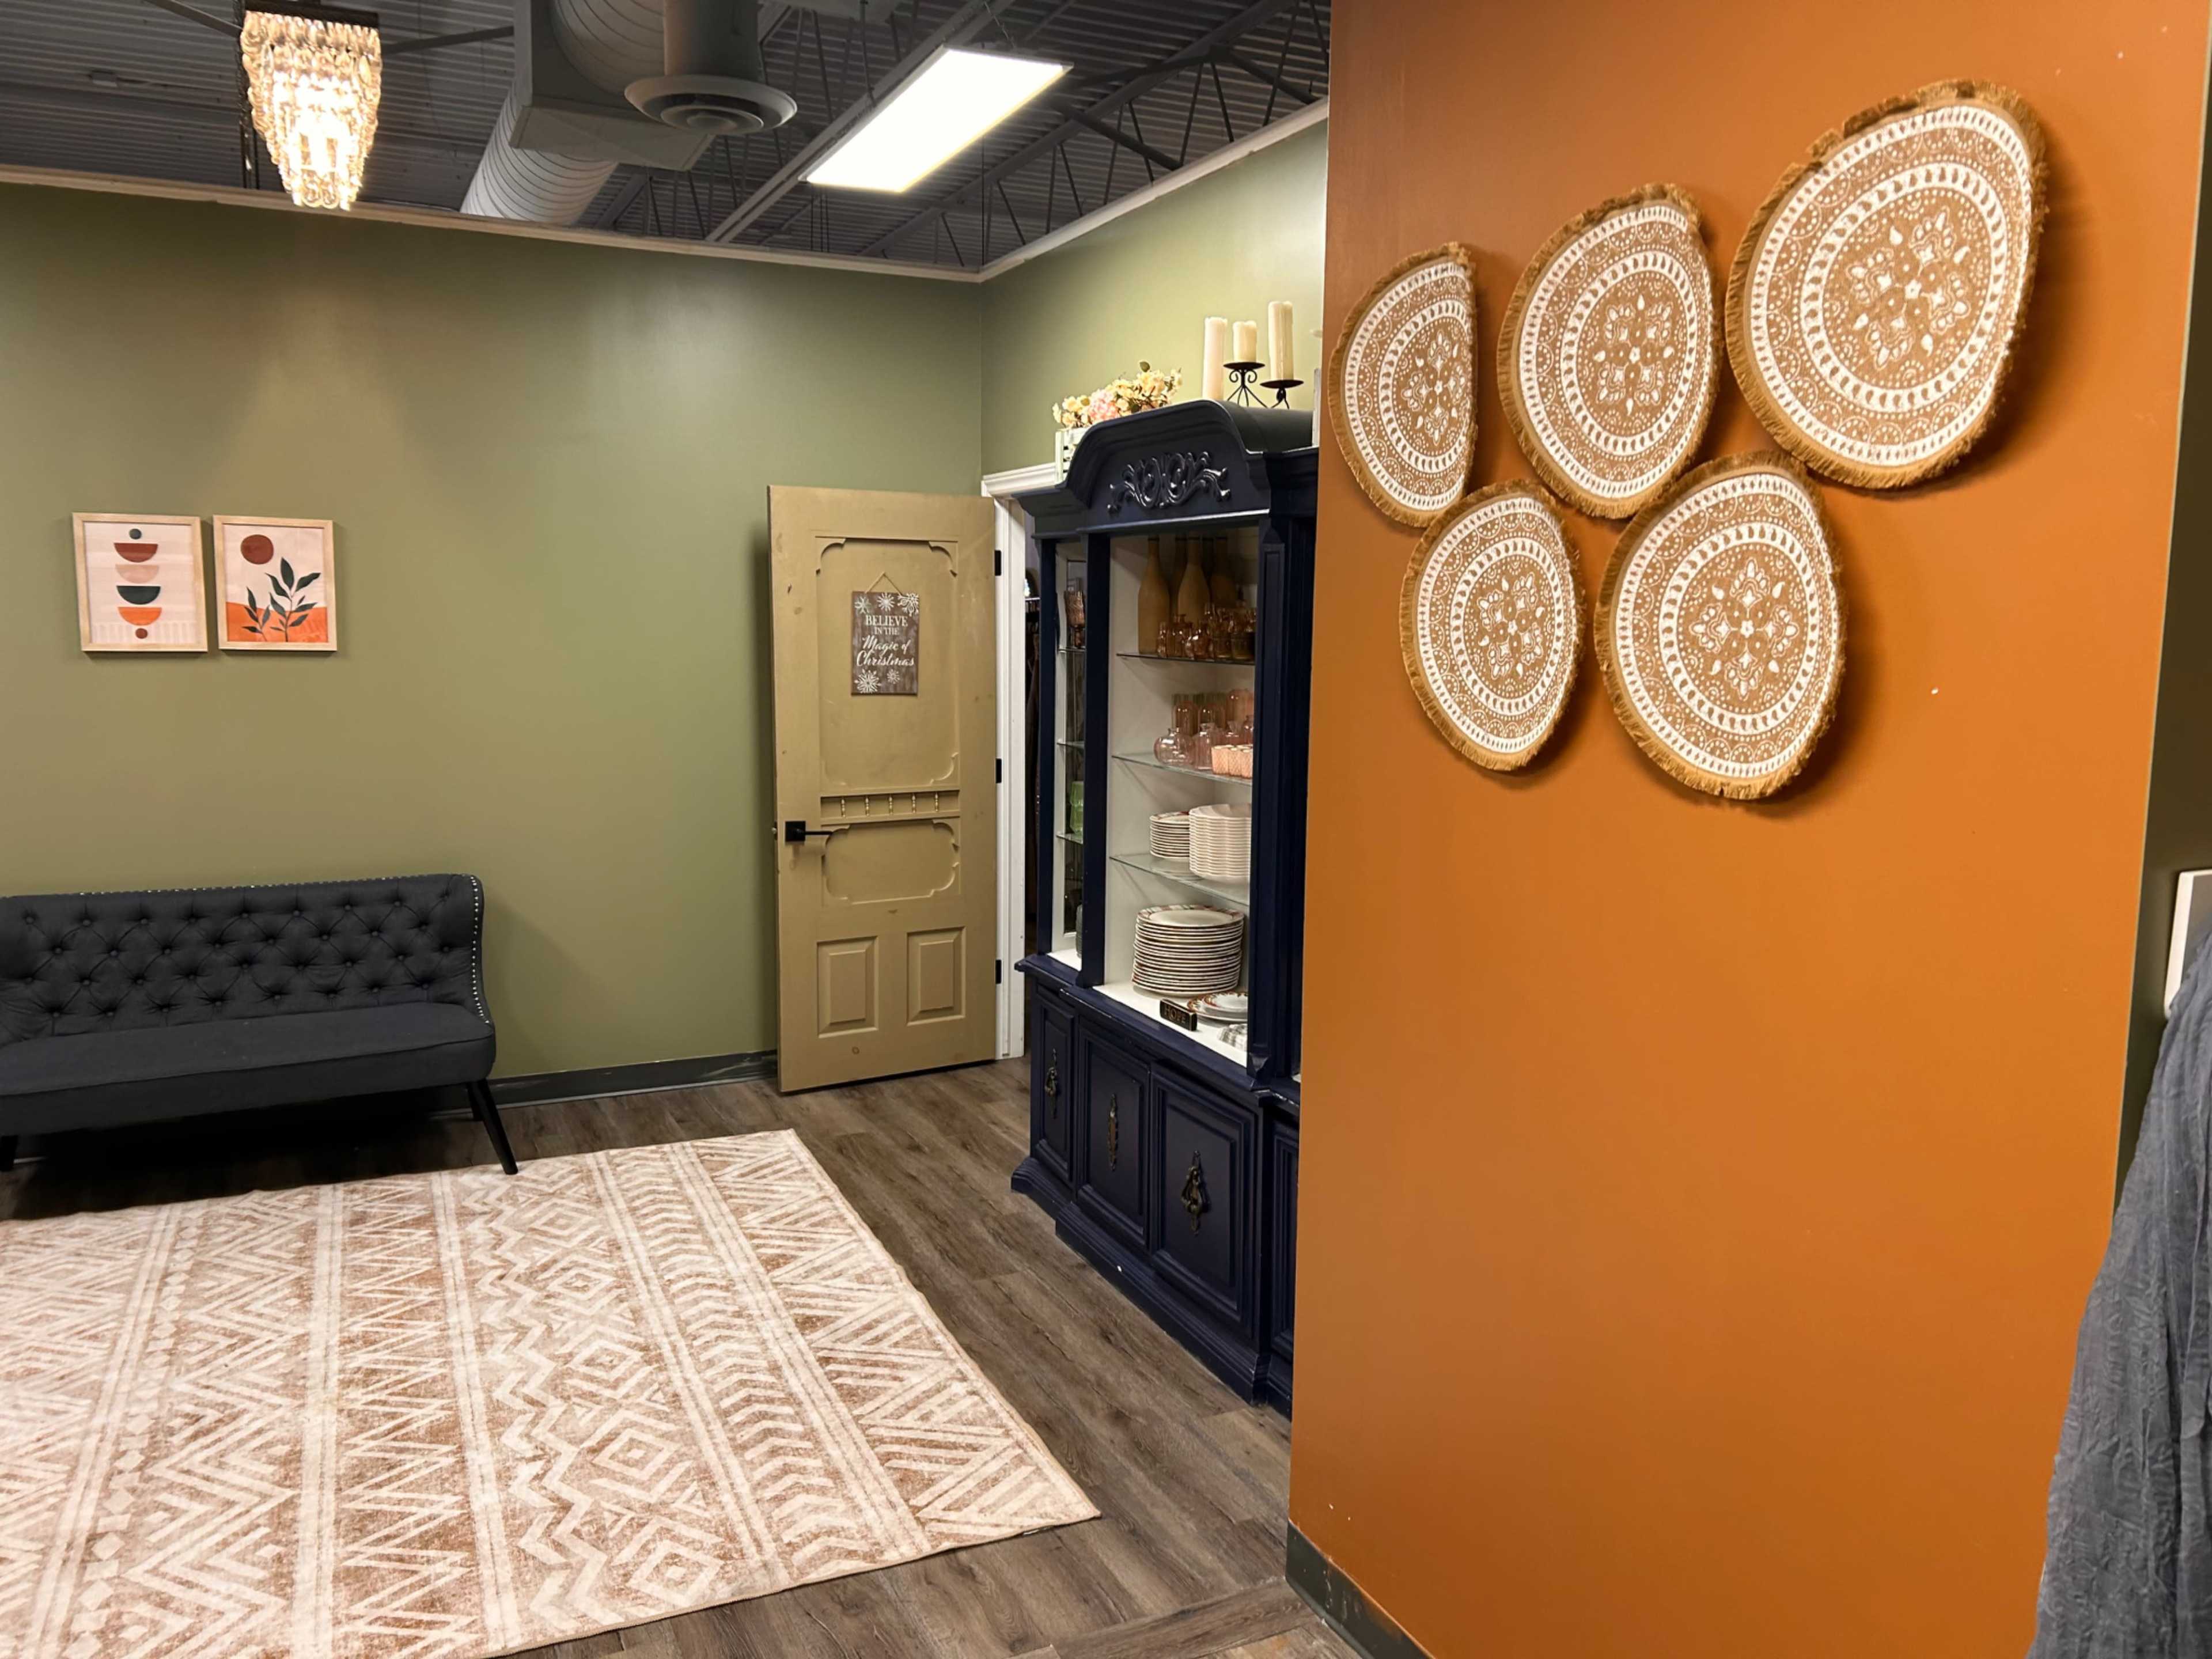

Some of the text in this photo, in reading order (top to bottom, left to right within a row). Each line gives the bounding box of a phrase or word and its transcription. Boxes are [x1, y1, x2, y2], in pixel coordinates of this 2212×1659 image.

[866, 615, 908, 627] BELIEVE
[874, 627, 899, 635] IN THE
[862, 635, 912, 657] Magic of
[857, 650, 915, 666] Christmas
[1164, 1003, 1187, 1024] HOPE
